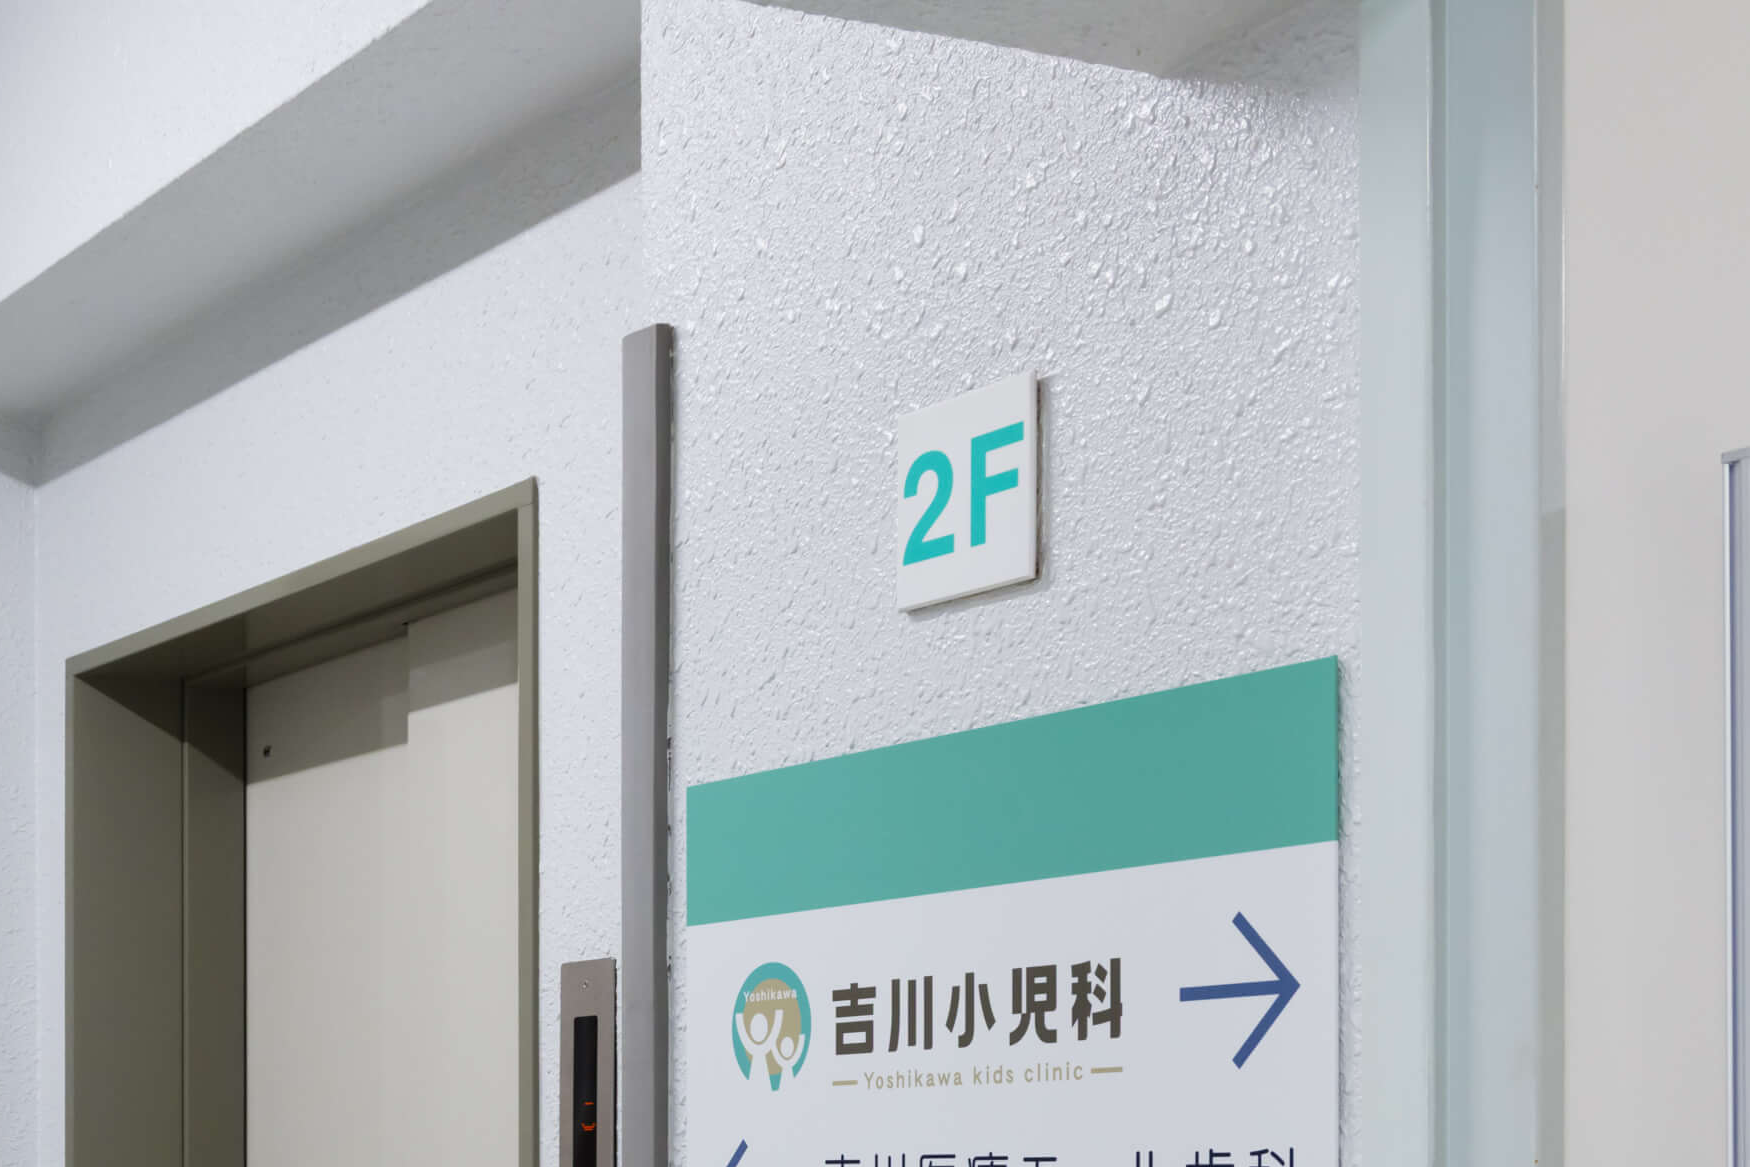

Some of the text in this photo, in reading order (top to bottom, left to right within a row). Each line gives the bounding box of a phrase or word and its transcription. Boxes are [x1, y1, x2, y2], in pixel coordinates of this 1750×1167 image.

[902, 420, 1025, 567] 2F
[832, 957, 1123, 1056] 吉川小児科
[863, 1061, 1084, 1090] Yoshikawa kids clinic
